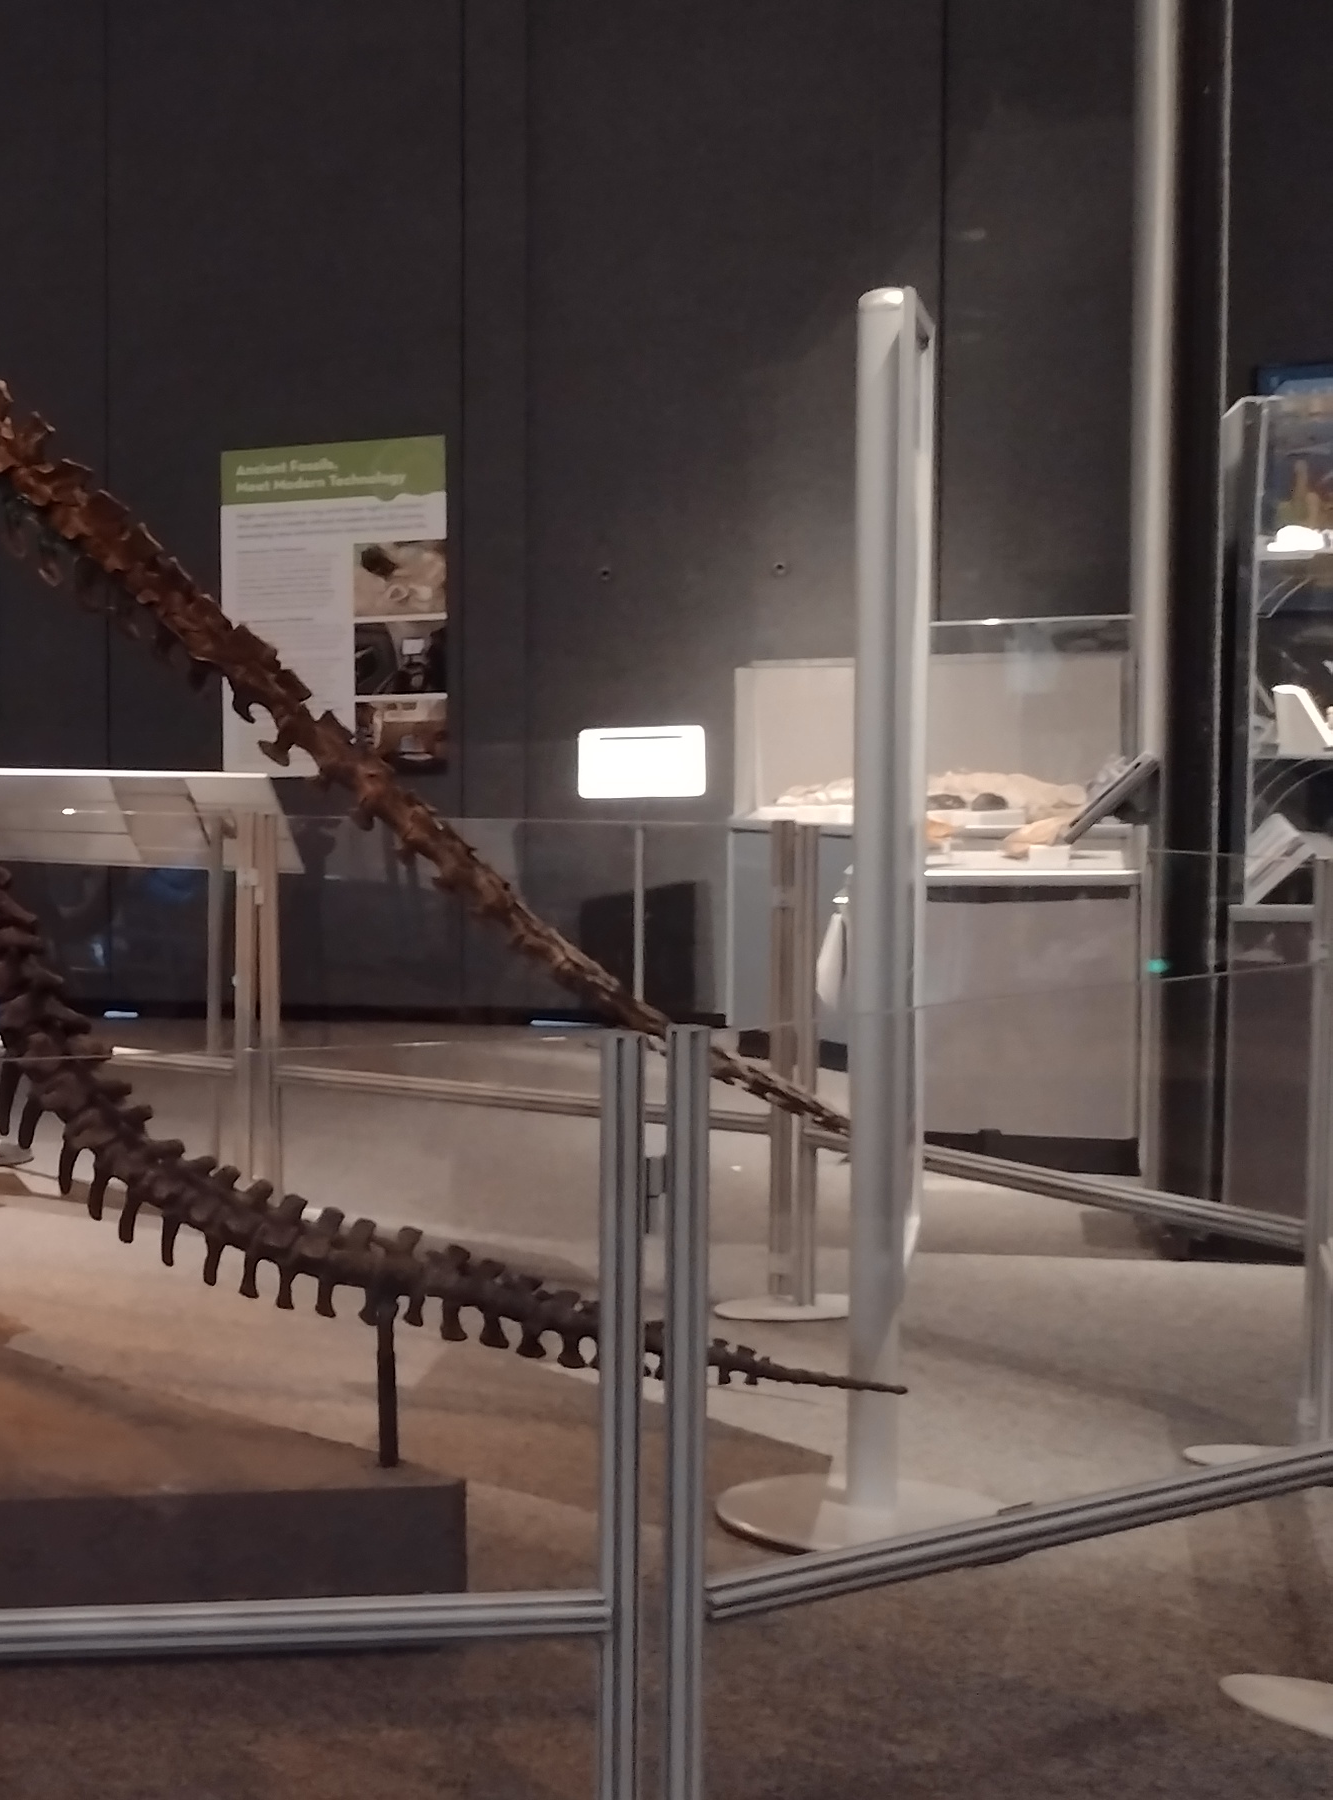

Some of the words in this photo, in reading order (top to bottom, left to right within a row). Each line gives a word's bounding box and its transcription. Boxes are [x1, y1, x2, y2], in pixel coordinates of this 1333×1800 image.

[235, 464, 287, 476] Ancient
[235, 480, 271, 493] Meet
[272, 476, 326, 490] Modern
[329, 472, 406, 487] Technology
